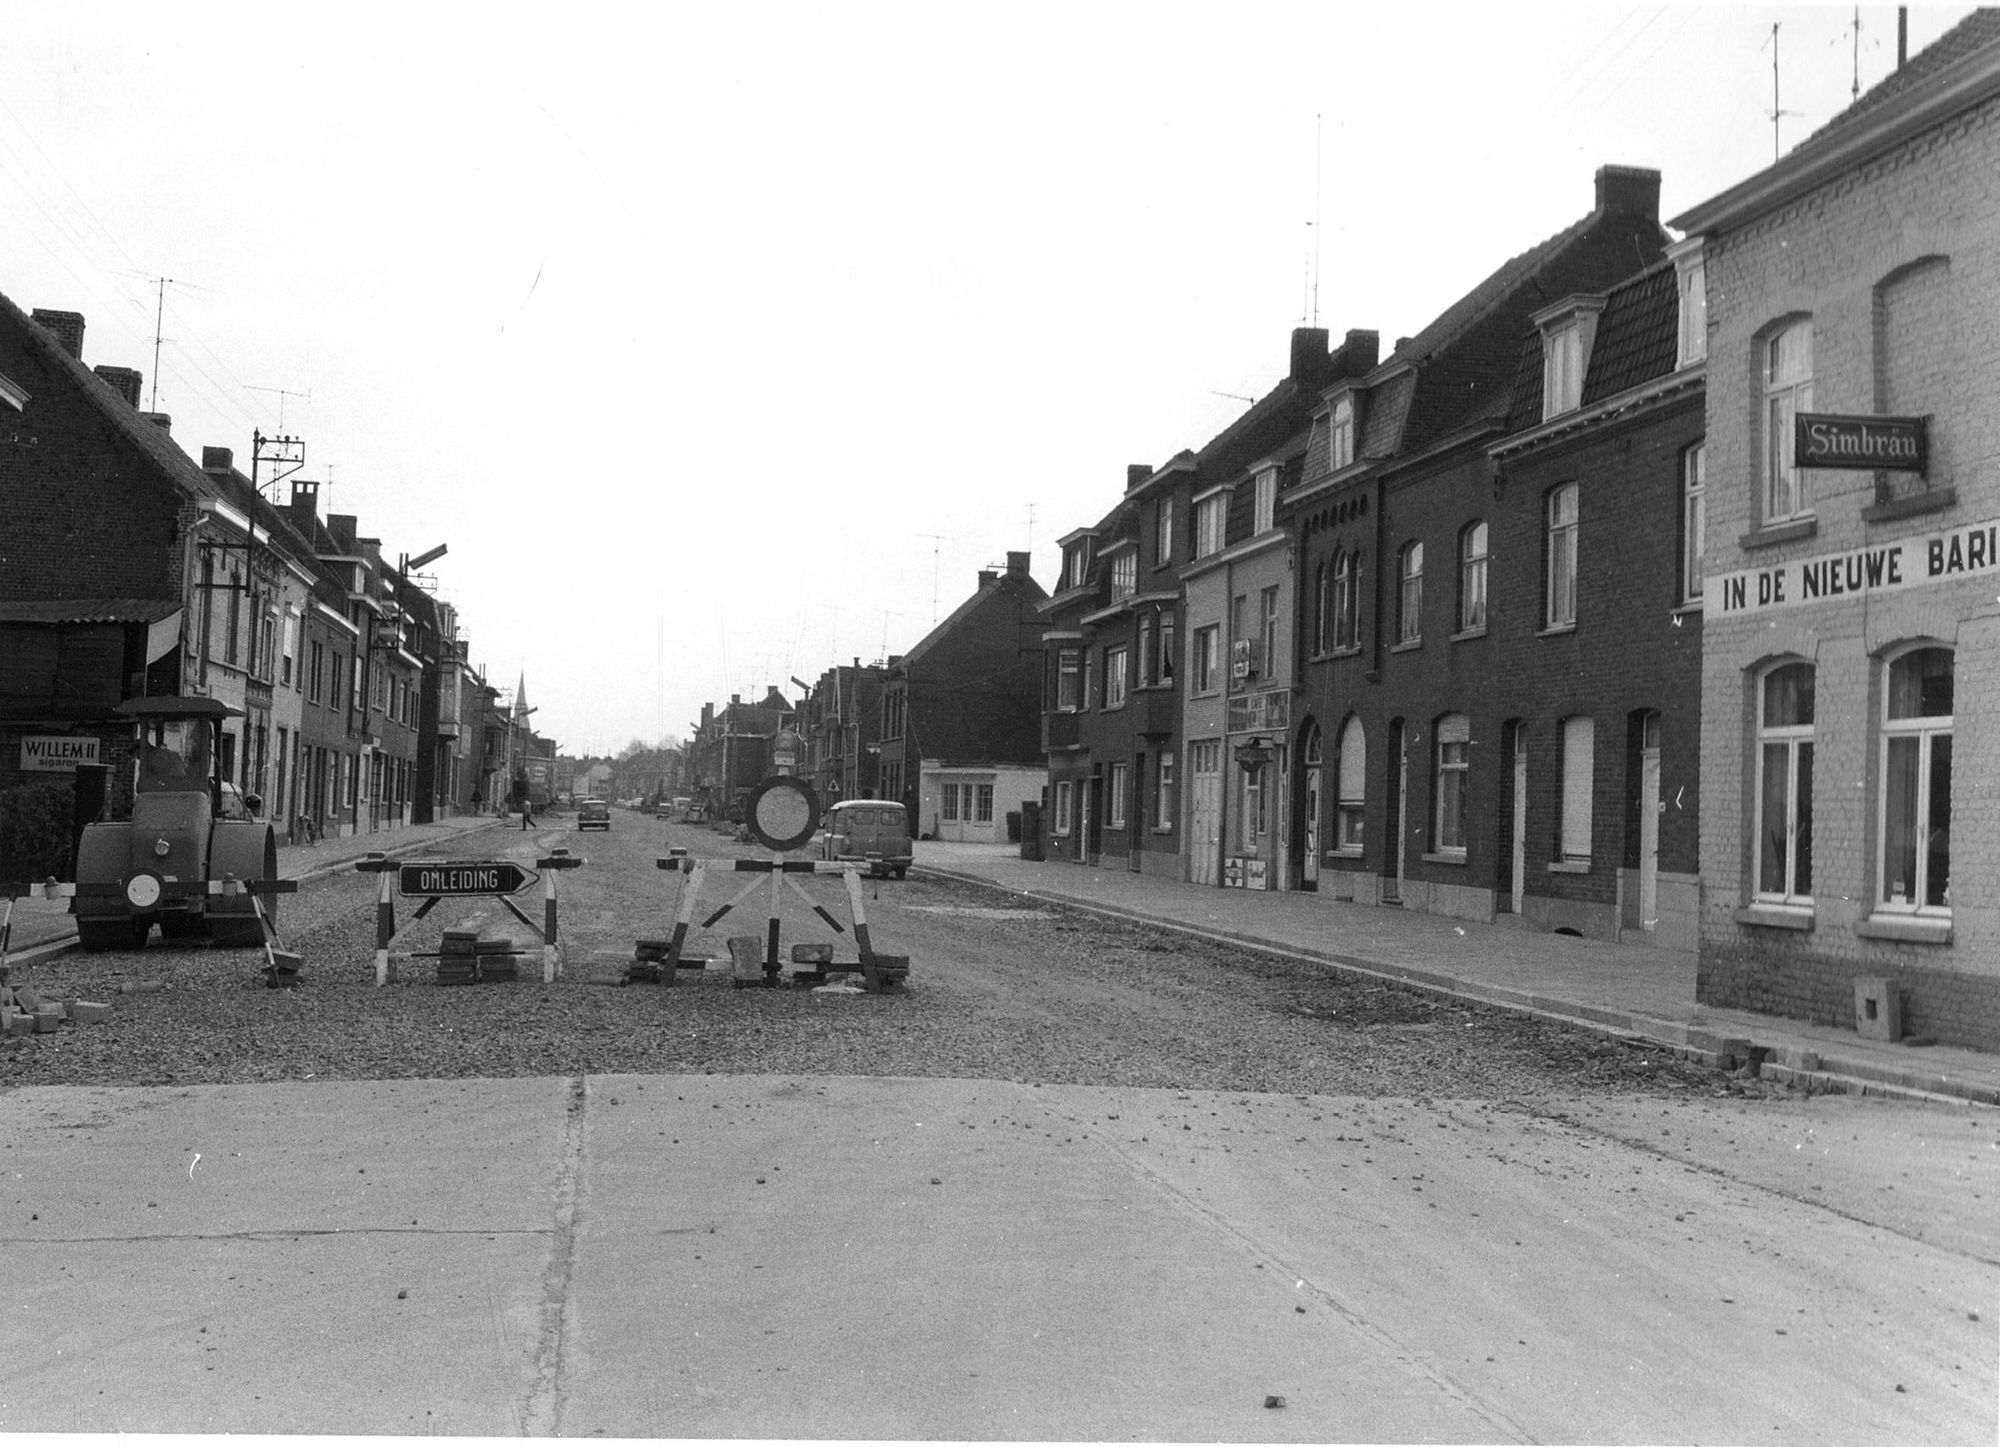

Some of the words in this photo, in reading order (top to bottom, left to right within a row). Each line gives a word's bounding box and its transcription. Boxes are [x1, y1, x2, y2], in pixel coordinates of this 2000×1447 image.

[1807, 424, 1918, 457] Simbräu
[1723, 576, 1746, 611] IN
[1758, 569, 1785, 605] DE
[1803, 547, 1902, 599] NIEUWE
[1928, 526, 1997, 577] BARI
[25, 741, 83, 758] WILLEM
[86, 743, 95, 758] II
[420, 870, 499, 890] OMLEIDING
